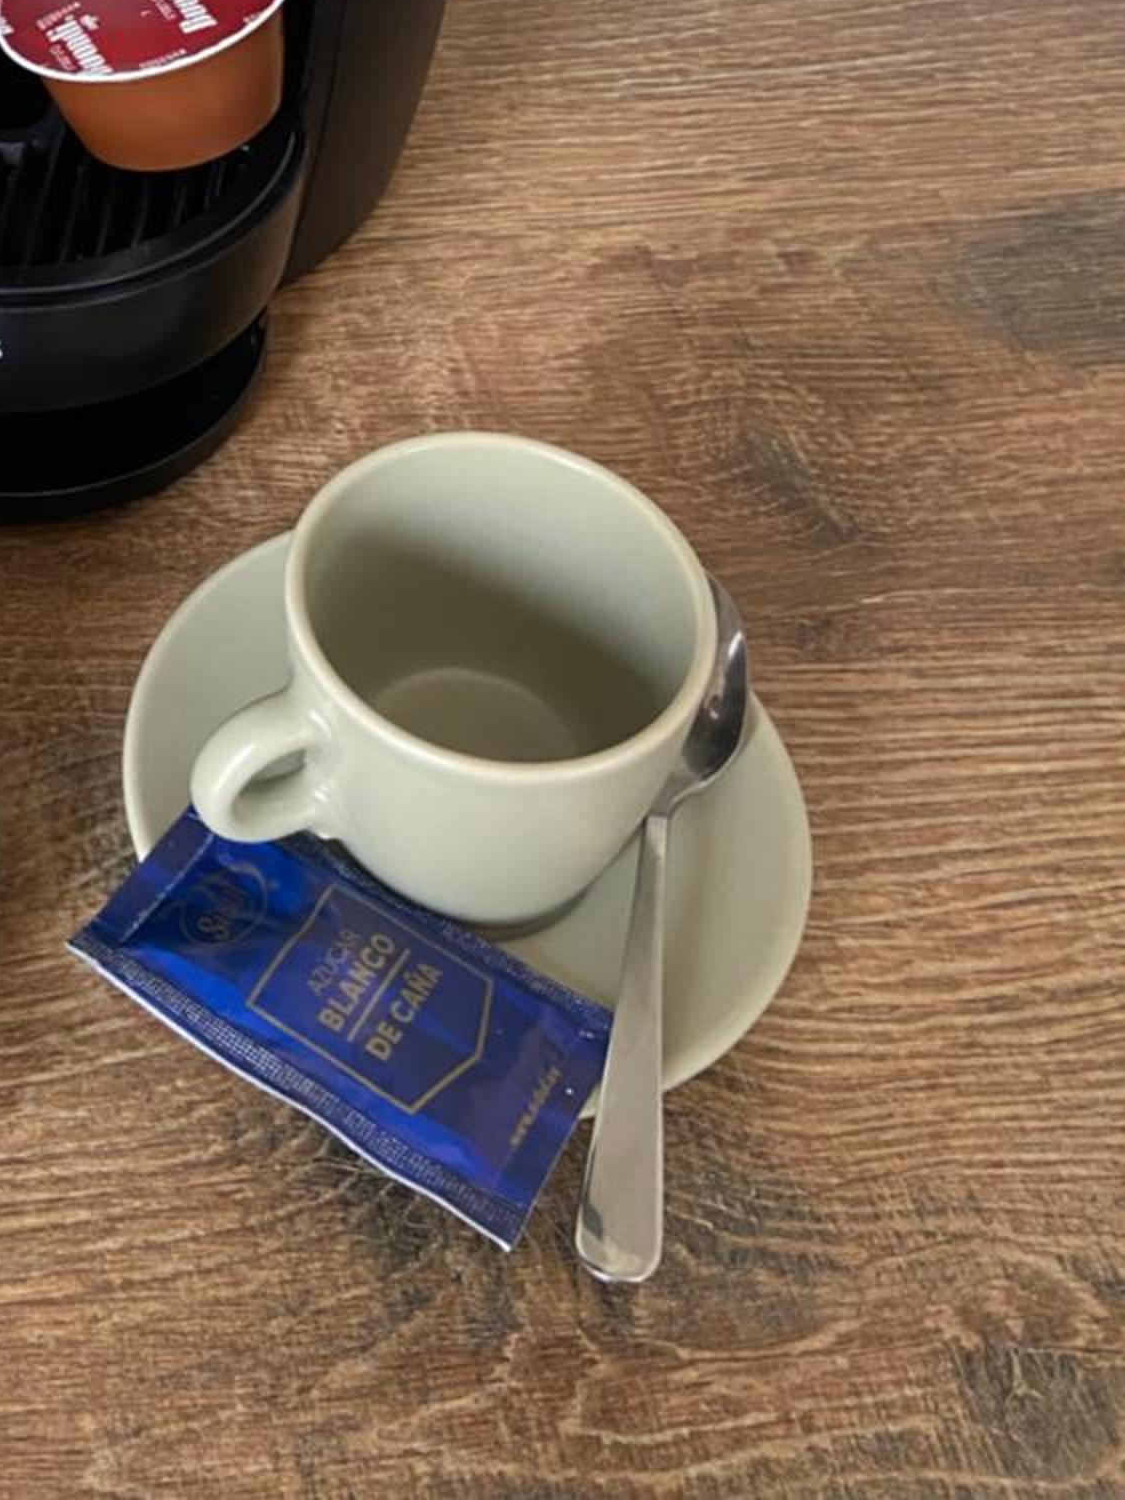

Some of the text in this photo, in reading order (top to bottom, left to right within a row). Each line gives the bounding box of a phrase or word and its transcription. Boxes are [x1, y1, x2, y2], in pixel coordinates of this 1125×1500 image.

[317, 932, 395, 1032] BLANCO
[365, 963, 443, 1061] DE CAÑA
